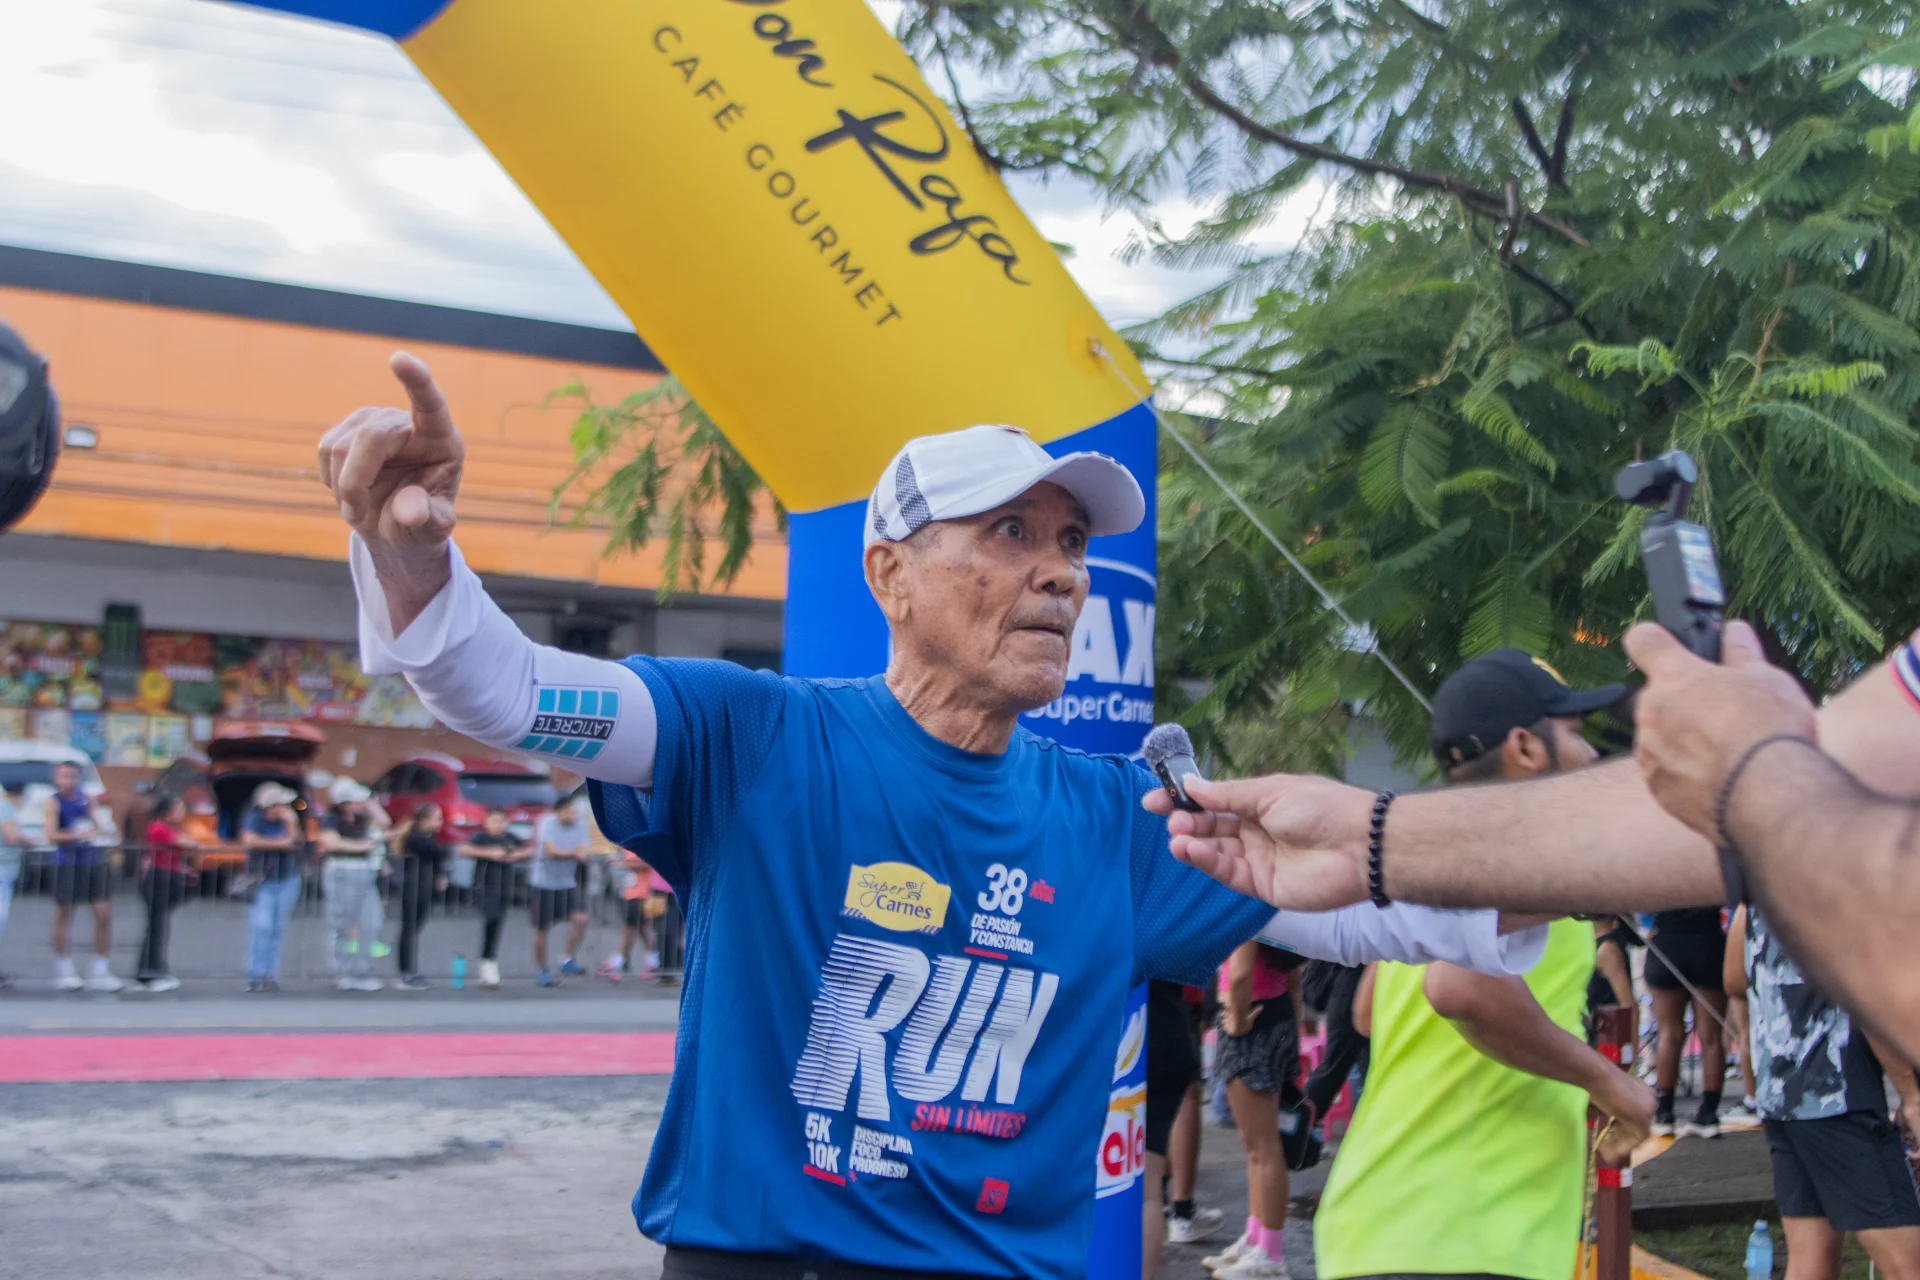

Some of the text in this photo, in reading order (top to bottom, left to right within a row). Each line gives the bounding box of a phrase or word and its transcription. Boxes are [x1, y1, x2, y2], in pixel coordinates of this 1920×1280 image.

[722, 0, 1032, 286] on Rafa
[653, 26, 902, 328] CAFÉ GOURMET
[1066, 595, 1156, 688] AX
[534, 716, 612, 738] LATICRETE
[858, 873, 905, 908] Super
[977, 863, 1028, 916] 38
[876, 895, 932, 920] Carnes
[971, 912, 1022, 936] DE PASIÓN
[979, 930, 1034, 955] CONSTANCIA
[789, 932, 1060, 1122] RUN
[805, 1111, 832, 1143] 5K
[911, 1103, 951, 1132] SIN
[851, 1140, 882, 1160] FOCO
[854, 1124, 913, 1155] DISCIPLINA
[807, 1140, 841, 1174] 10K
[849, 1155, 909, 1179] PROGRESO
